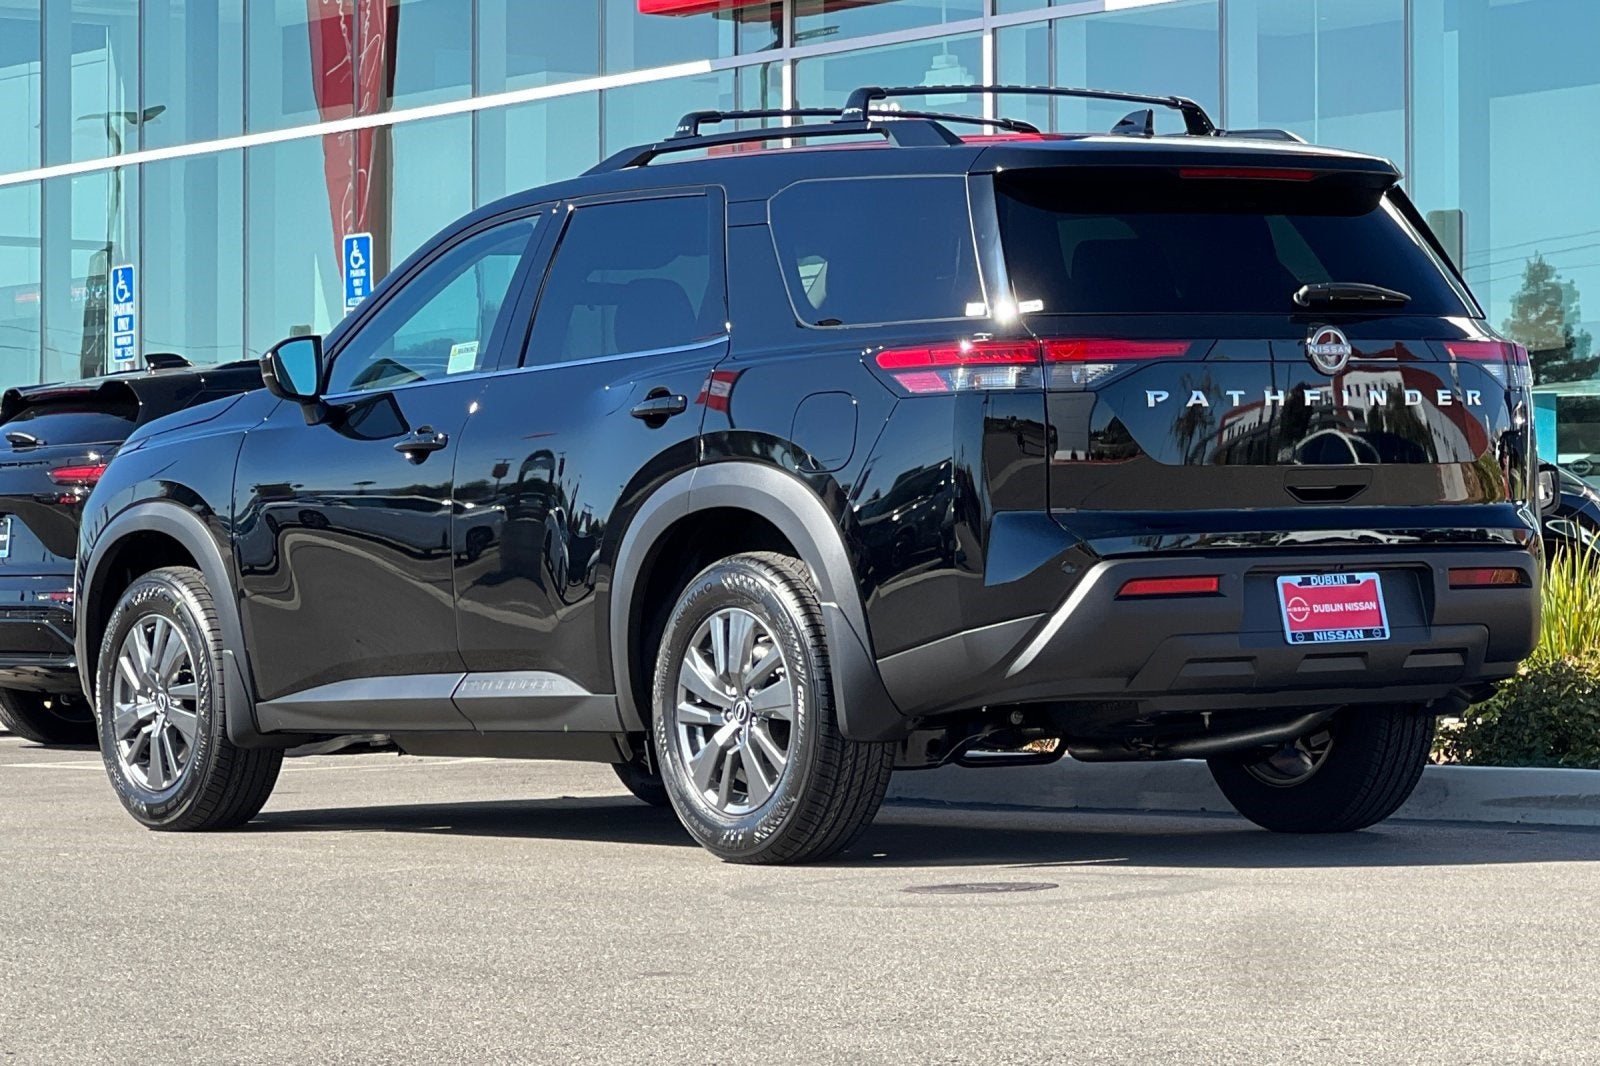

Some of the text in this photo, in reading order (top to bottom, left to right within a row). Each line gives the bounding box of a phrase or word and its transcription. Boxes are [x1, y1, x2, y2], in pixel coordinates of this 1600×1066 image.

[113, 301, 134, 317] PARKING
[117, 317, 130, 331] ONLY
[1309, 344, 1351, 354] NISSAN
[1145, 390, 1482, 408] PATHFINDER
[1311, 575, 1347, 586] DUBLIN
[1312, 601, 1377, 613] DUBLIN NISSAN
[1313, 630, 1364, 641] NISSAN
